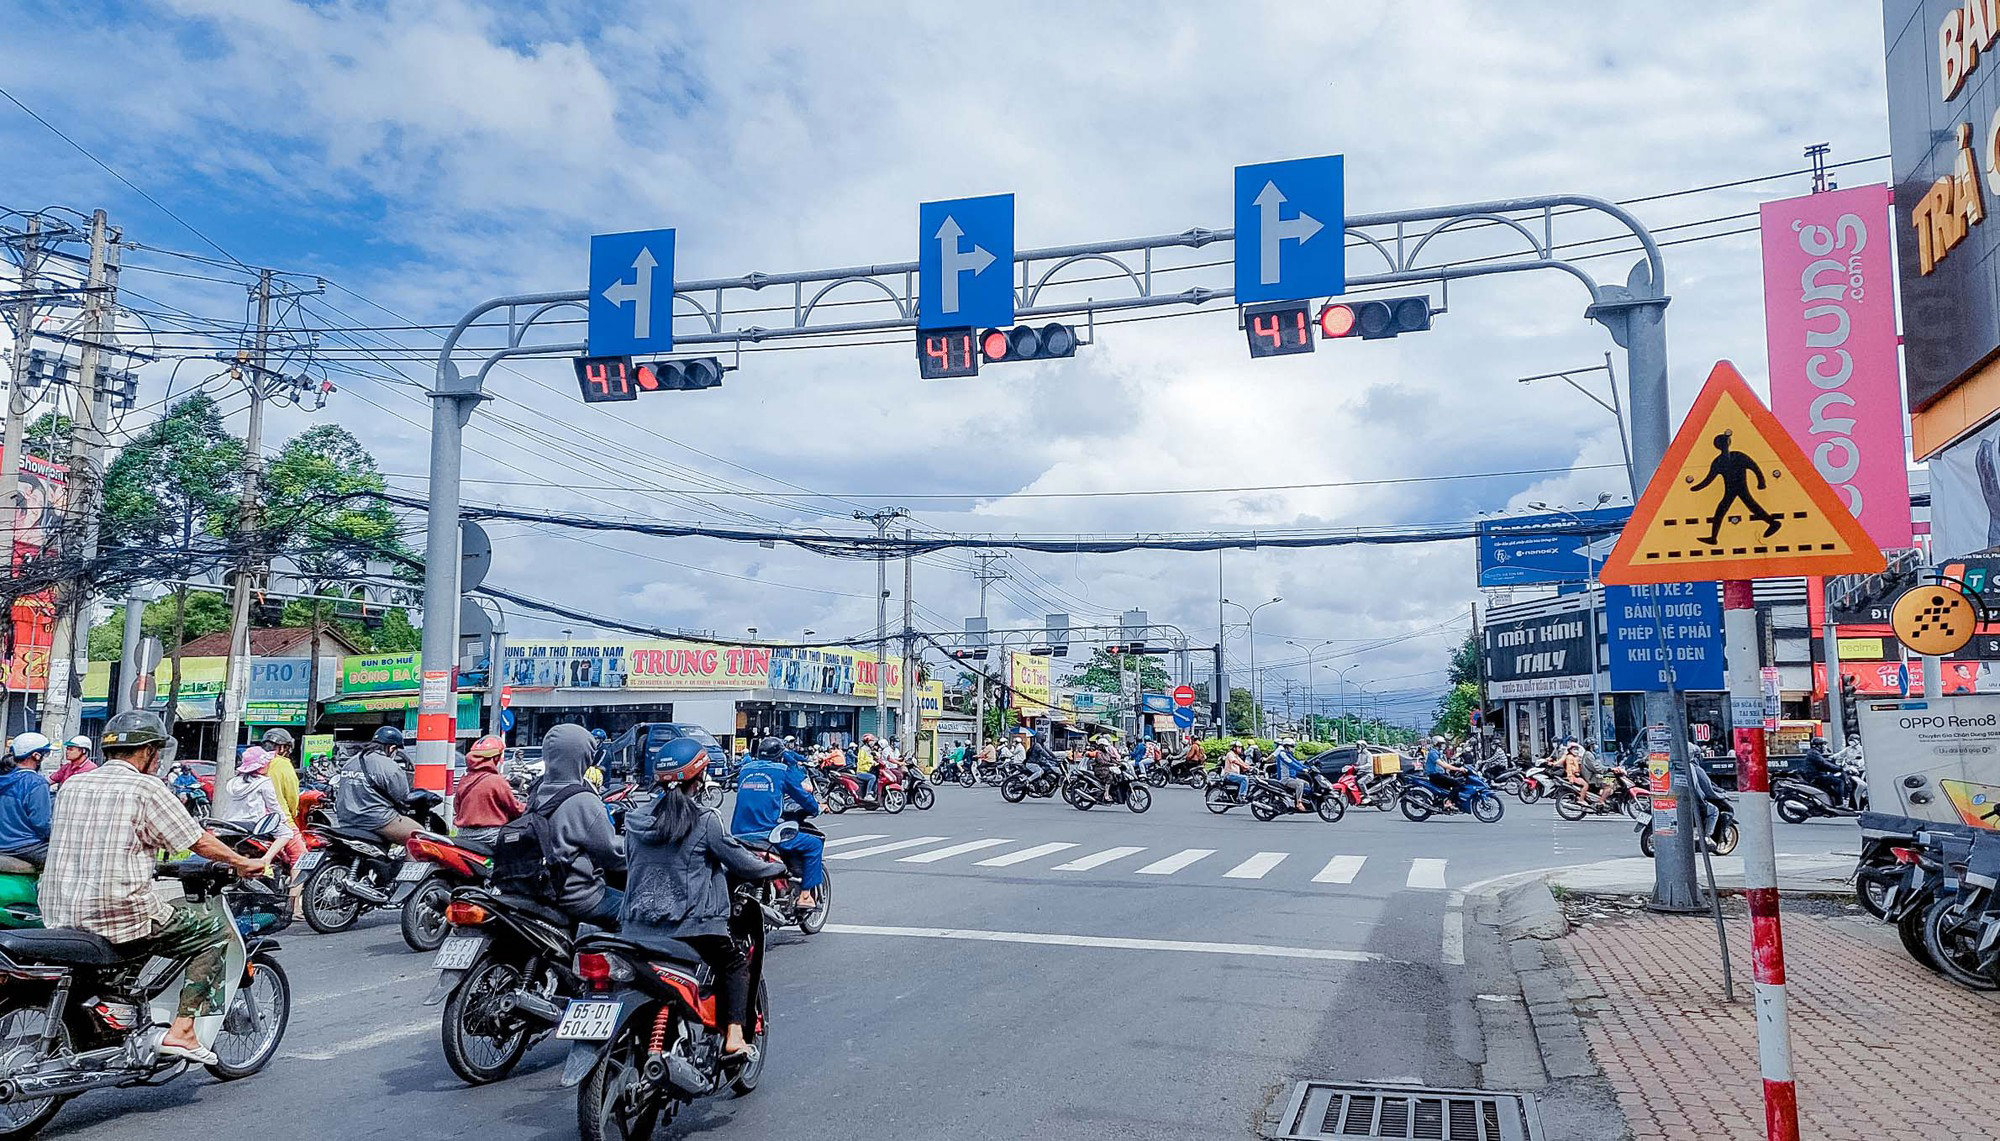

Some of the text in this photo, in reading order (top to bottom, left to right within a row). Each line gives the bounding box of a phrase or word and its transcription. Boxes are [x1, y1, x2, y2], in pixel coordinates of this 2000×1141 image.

[1254, 312, 1308, 348] 41
[926, 335, 971, 371] 41
[585, 363, 629, 395] 41
[1664, 583, 1681, 596] XE
[1685, 583, 1694, 596] 2
[1665, 603, 1702, 620] ĐƯỢC
[1871, 608, 1888, 619] Đi
[1618, 624, 1653, 640] PHÉP
[1679, 621, 1711, 639] PHẢI
[505, 646, 525, 658] RUNG
[572, 646, 600, 657] TRANG
[602, 646, 624, 657] NAM
[1628, 648, 1651, 662] KHI
[1677, 645, 1705, 661] ĐÈN
[1841, 643, 1879, 653] realme
[632, 648, 718, 677] TRUNG
[1516, 650, 1566, 674] ITALY
[1900, 714, 1997, 729] OPPO Reno8
[561, 1020, 609, 1037] 504.74
